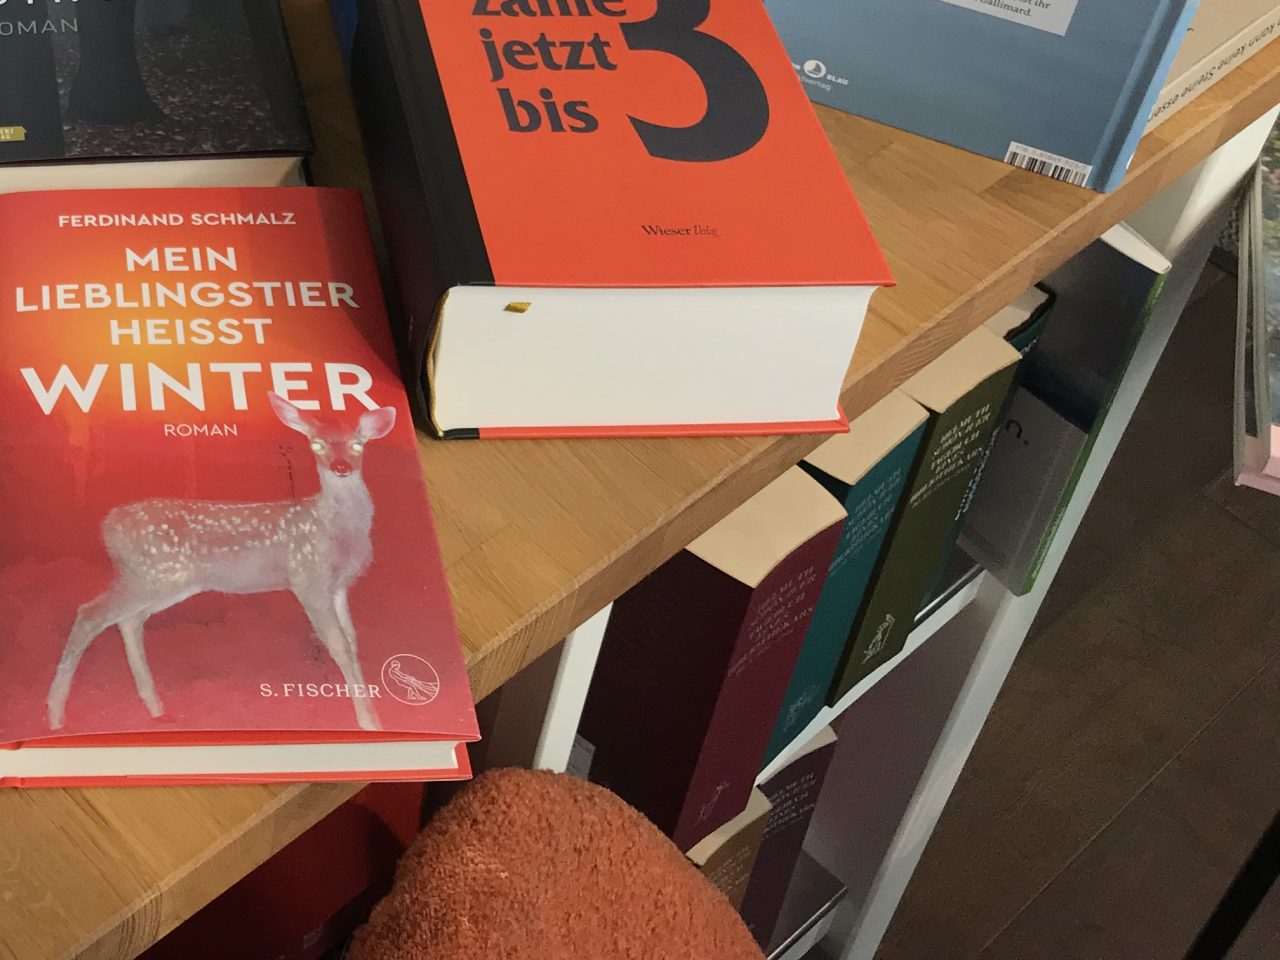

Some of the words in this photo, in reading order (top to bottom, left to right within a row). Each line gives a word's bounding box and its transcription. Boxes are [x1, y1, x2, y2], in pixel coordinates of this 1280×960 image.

[479, 26, 618, 82] jetzt
[497, 87, 599, 133] bis
[58, 213, 184, 228] FERDINAND
[191, 212, 296, 226] SCHMALZ
[641, 224, 691, 237] Wieser
[126, 247, 237, 272] MEIN
[15, 282, 360, 312] LIEBLINGSTIER
[109, 318, 273, 346] HEISST
[20, 362, 380, 415] WINTER
[163, 423, 238, 438] ROMAN
[259, 683, 278, 696] S.
[283, 682, 381, 699] FISCHER
